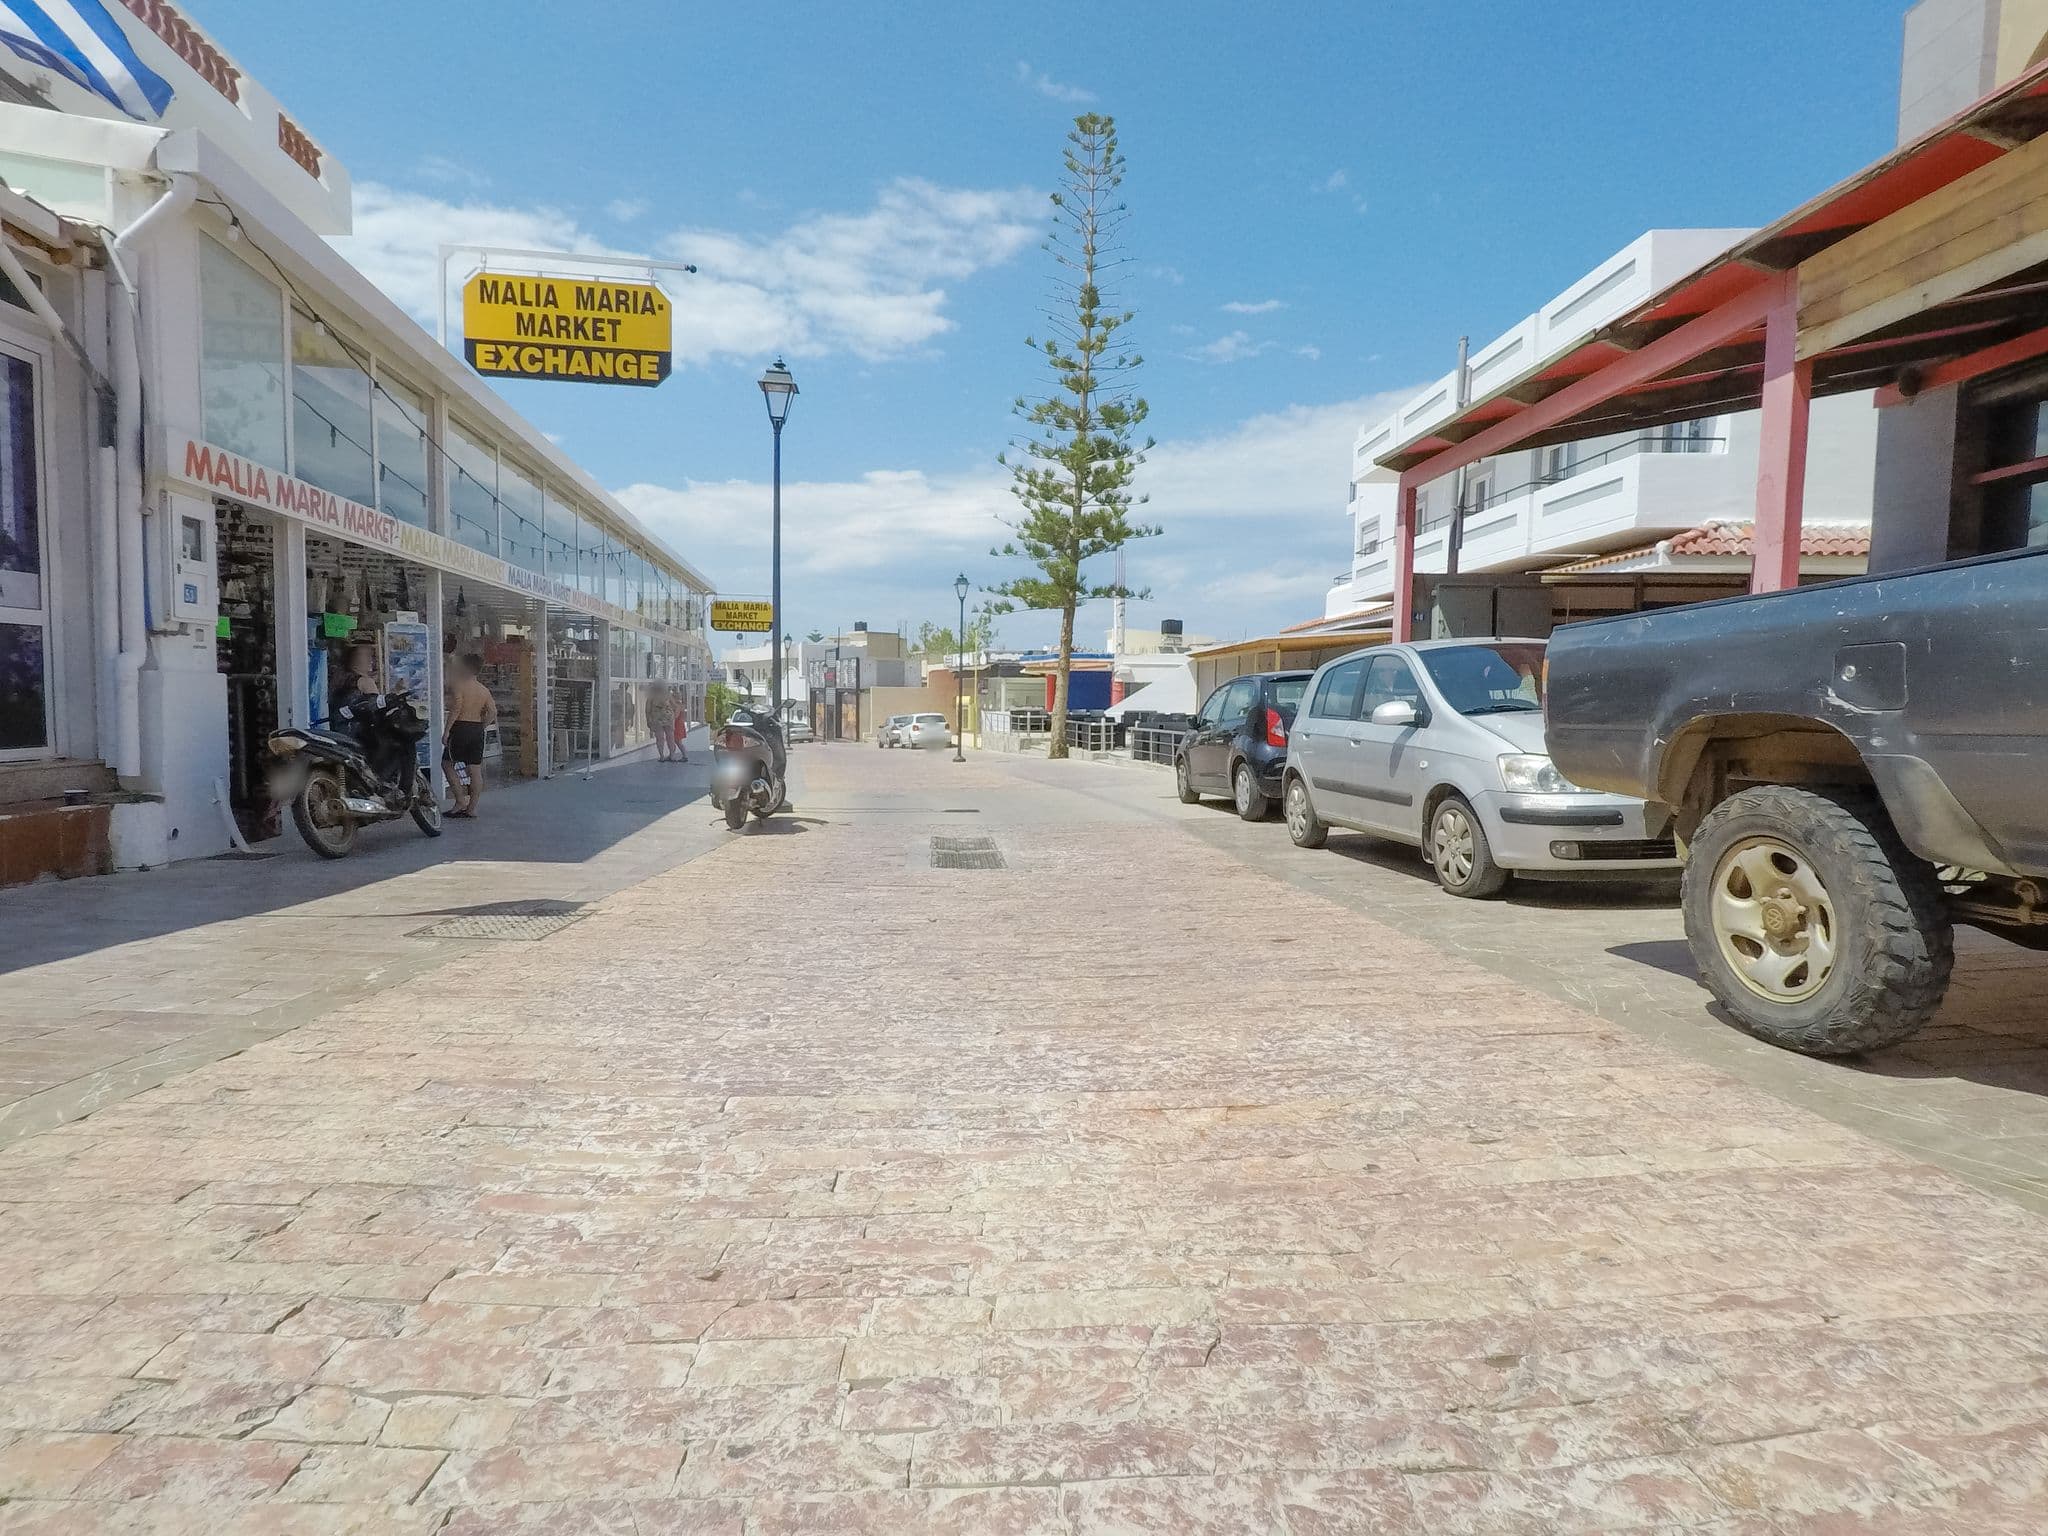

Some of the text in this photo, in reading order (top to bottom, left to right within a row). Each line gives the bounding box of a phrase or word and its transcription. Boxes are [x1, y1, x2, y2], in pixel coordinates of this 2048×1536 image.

[479, 278, 560, 309] MALIA
[516, 312, 622, 343] MARKET
[474, 343, 661, 381] EXCHANGE
[185, 440, 396, 545] MALIA MARIA MARKET
[401, 525, 440, 562] MALIA
[508, 565, 531, 591] MALIA
[715, 602, 740, 611] MALIA
[725, 611, 758, 620] MARKET
[714, 621, 770, 631] EXCHANGE
